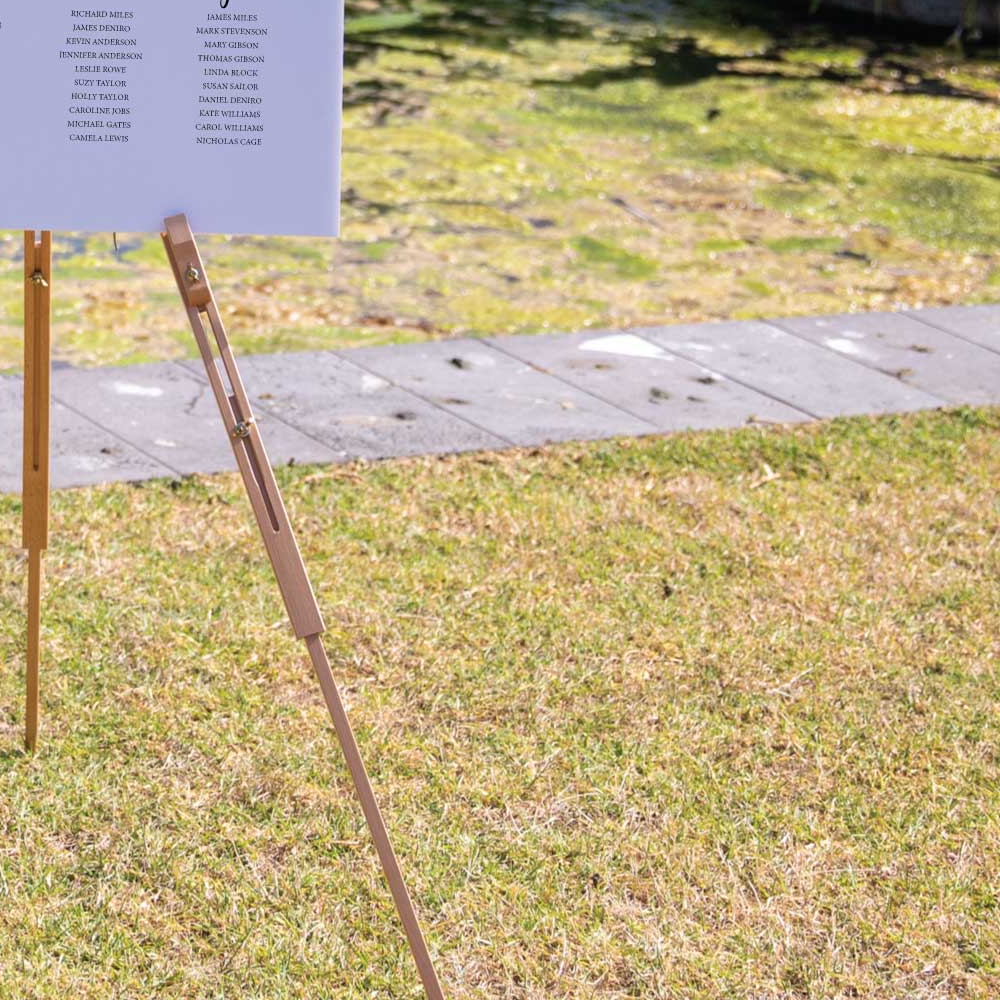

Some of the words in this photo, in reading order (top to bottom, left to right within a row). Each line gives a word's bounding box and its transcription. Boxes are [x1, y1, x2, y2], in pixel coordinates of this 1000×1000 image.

[70, 9, 108, 18] RICHARD
[108, 10, 134, 19] MILES
[206, 12, 232, 21] JAMES
[232, 13, 258, 22] MILES
[195, 26, 220, 35] MARK
[219, 26, 268, 36] STEVENSON
[65, 36, 91, 45] KEVIN
[91, 37, 137, 46] ANDERSON
[203, 40, 228, 49] MARY
[227, 41, 259, 49] GIBSON
[197, 54, 233, 63] THOMAS
[232, 54, 265, 63] GIBSON
[74, 64, 101, 73] LESLIE
[101, 65, 127, 73] ROWE
[203, 67, 229, 76] LINDA
[230, 68, 259, 77] BLOCK
[73, 78, 95, 87] SUZY
[94, 78, 127, 87] TAYLOR
[70, 92, 98, 100] HOLLY
[97, 92, 129, 101] TAYLOR
[198, 95, 228, 104] DANIEL
[229, 95, 262, 104] DENIRO
[68, 106, 111, 114] CAROLINE
[111, 106, 130, 115] JOBS
[66, 119, 105, 128] MICHAEL
[105, 120, 131, 129] GATES
[68, 133, 103, 142] CAMELA
[103, 134, 129, 142] LEWIS
[195, 136, 239, 145] NICHOLAS
[239, 137, 262, 146] CAGE
